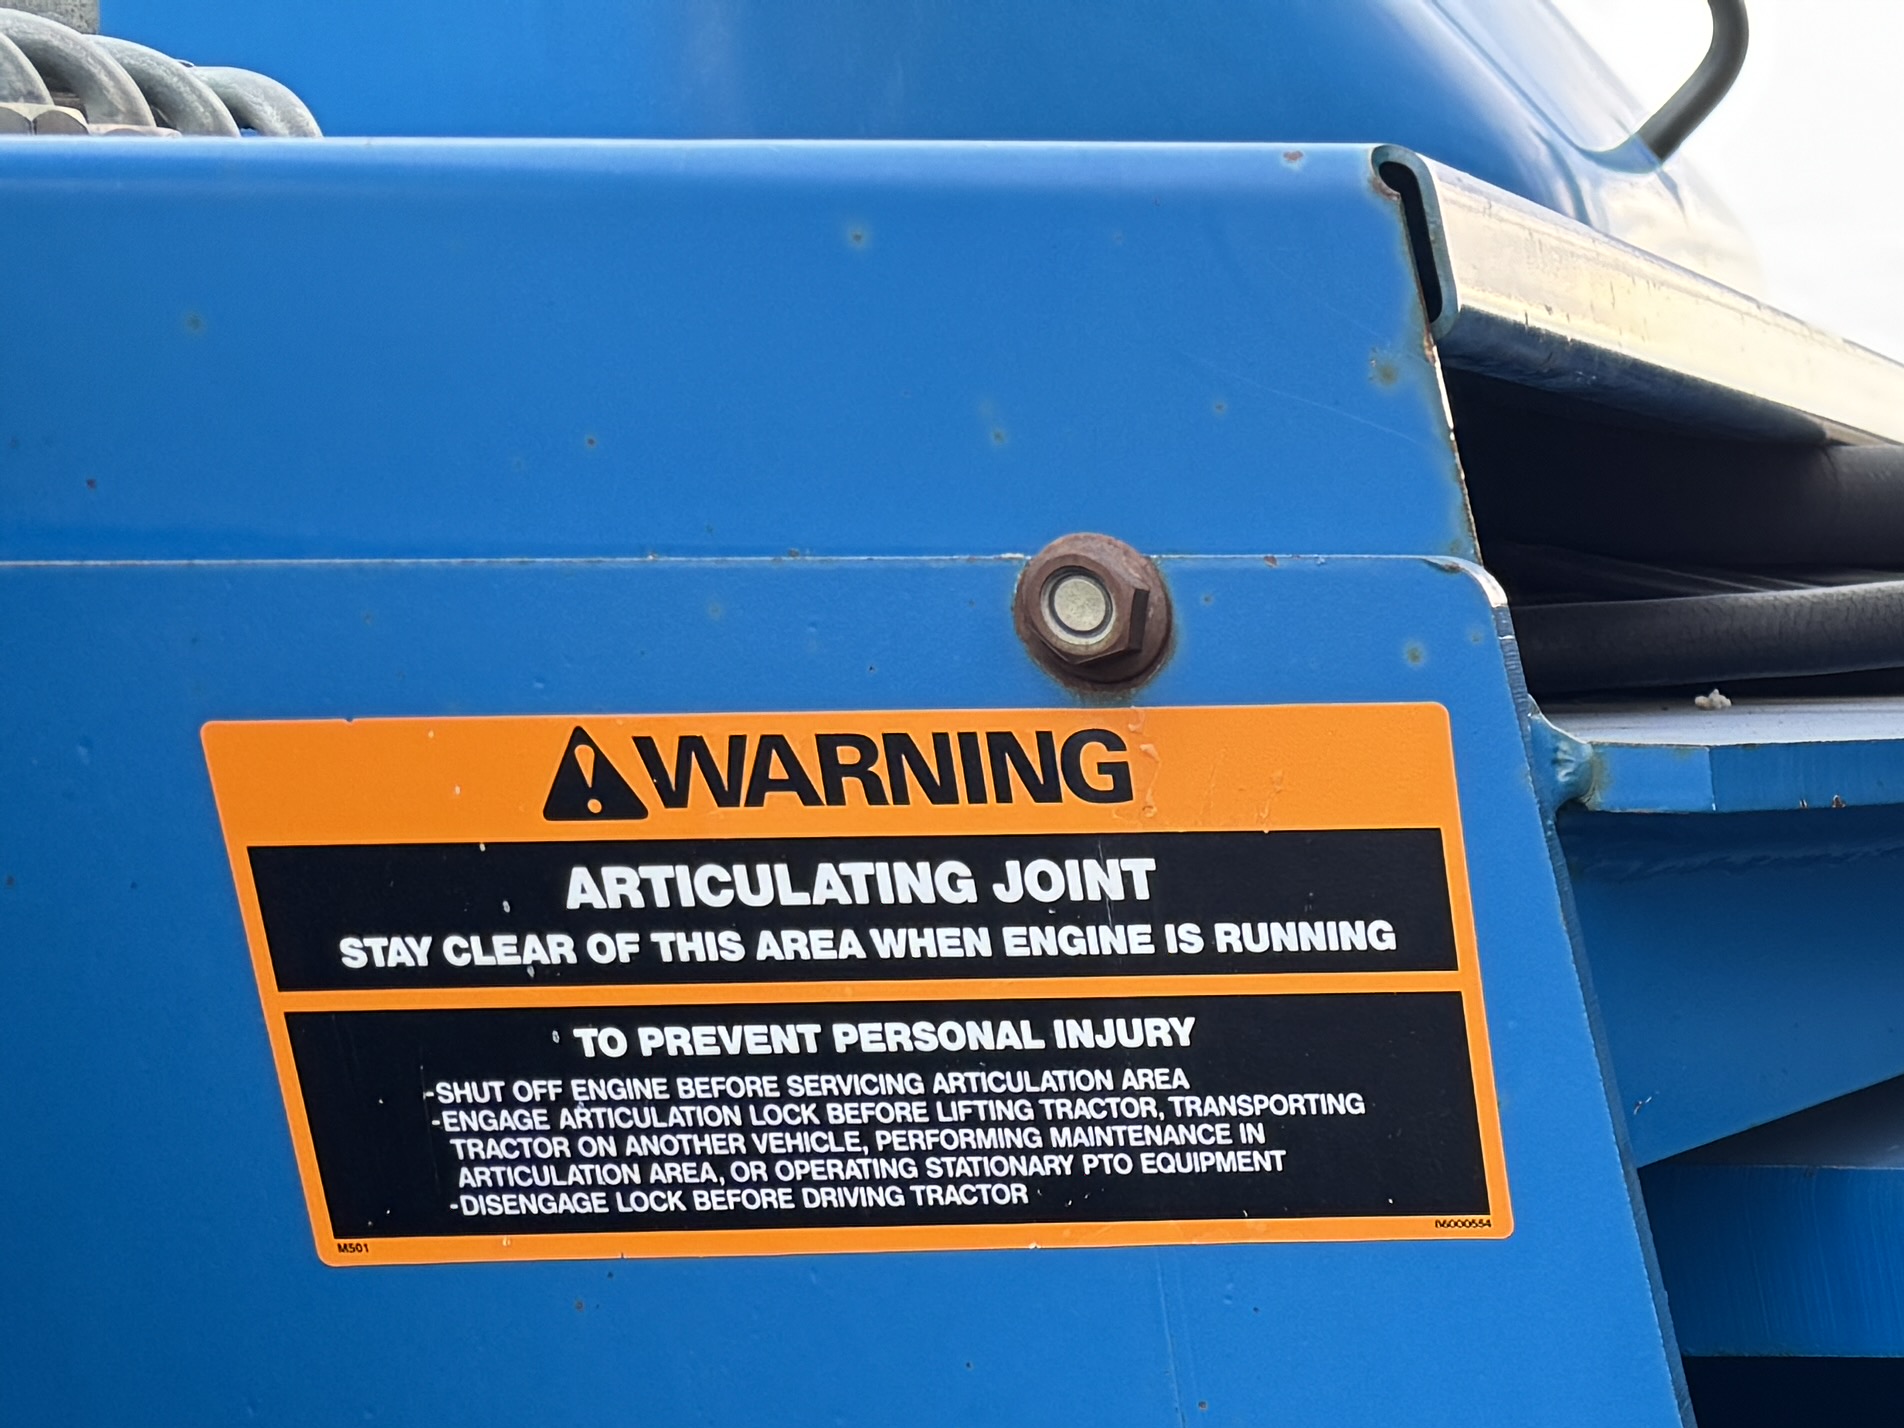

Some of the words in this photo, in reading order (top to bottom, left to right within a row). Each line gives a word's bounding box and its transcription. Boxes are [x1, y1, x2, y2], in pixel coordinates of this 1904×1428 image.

[632, 728, 1134, 809] WARNING
[566, 859, 978, 910] ARTICULATING
[992, 857, 1157, 904] JOINT
[339, 935, 433, 969] STAY
[442, 933, 578, 967] CLEAR
[586, 932, 640, 965] OF
[649, 929, 746, 963] THIS
[756, 928, 867, 961] AREA
[868, 926, 993, 959] WHEN
[1001, 923, 1156, 957] ENGINE
[1164, 922, 1205, 954] IS
[1213, 919, 1397, 954] RUNNING
[572, 1026, 628, 1058] TO
[637, 1023, 822, 1057] PREVENT
[831, 1019, 1046, 1054] PERSONAL
[1052, 1016, 1196, 1049] INJURY
[512, 1079, 563, 1103] OFF
[571, 1077, 671, 1102] ENGINE
[675, 1075, 781, 1100] BEFORE
[786, 1072, 925, 1098] SERVICING
[932, 1068, 1114, 1095] ARTICULATION
[1121, 1067, 1191, 1091] AREA
[559, 1104, 743, 1130] ARTICULATION
[748, 1102, 821, 1126] LOCK
[825, 1100, 930, 1125] BEFORE
[935, 1098, 1035, 1123] LIFTING
[1037, 1096, 1165, 1121] TRACTOR,
[1167, 1092, 1366, 1118] TRANSPORTING
[449, 1136, 572, 1161] TRACTOR
[577, 1135, 618, 1158] ON
[625, 1132, 747, 1157] ANOTHER
[750, 1130, 869, 1156] VEHICLE,
[874, 1126, 1044, 1152] PERFORMING
[1049, 1122, 1234, 1148] MAINTENANCE
[1238, 1122, 1266, 1145] IN
[458, 1162, 642, 1189] ARTICULATION
[649, 1161, 726, 1187] AREA,
[729, 1160, 769, 1183] OR
[774, 1157, 919, 1182] OPERATING
[924, 1153, 1074, 1179] STATIONARY
[1081, 1152, 1134, 1176] PTO
[1139, 1149, 1287, 1174] EQUIPMENT
[615, 1190, 687, 1213] LOCK
[692, 1187, 796, 1211] BEFORE
[801, 1185, 906, 1209] DRIVING
[909, 1182, 1029, 1207] TRACTOR
[337, 1242, 369, 1253] M501
